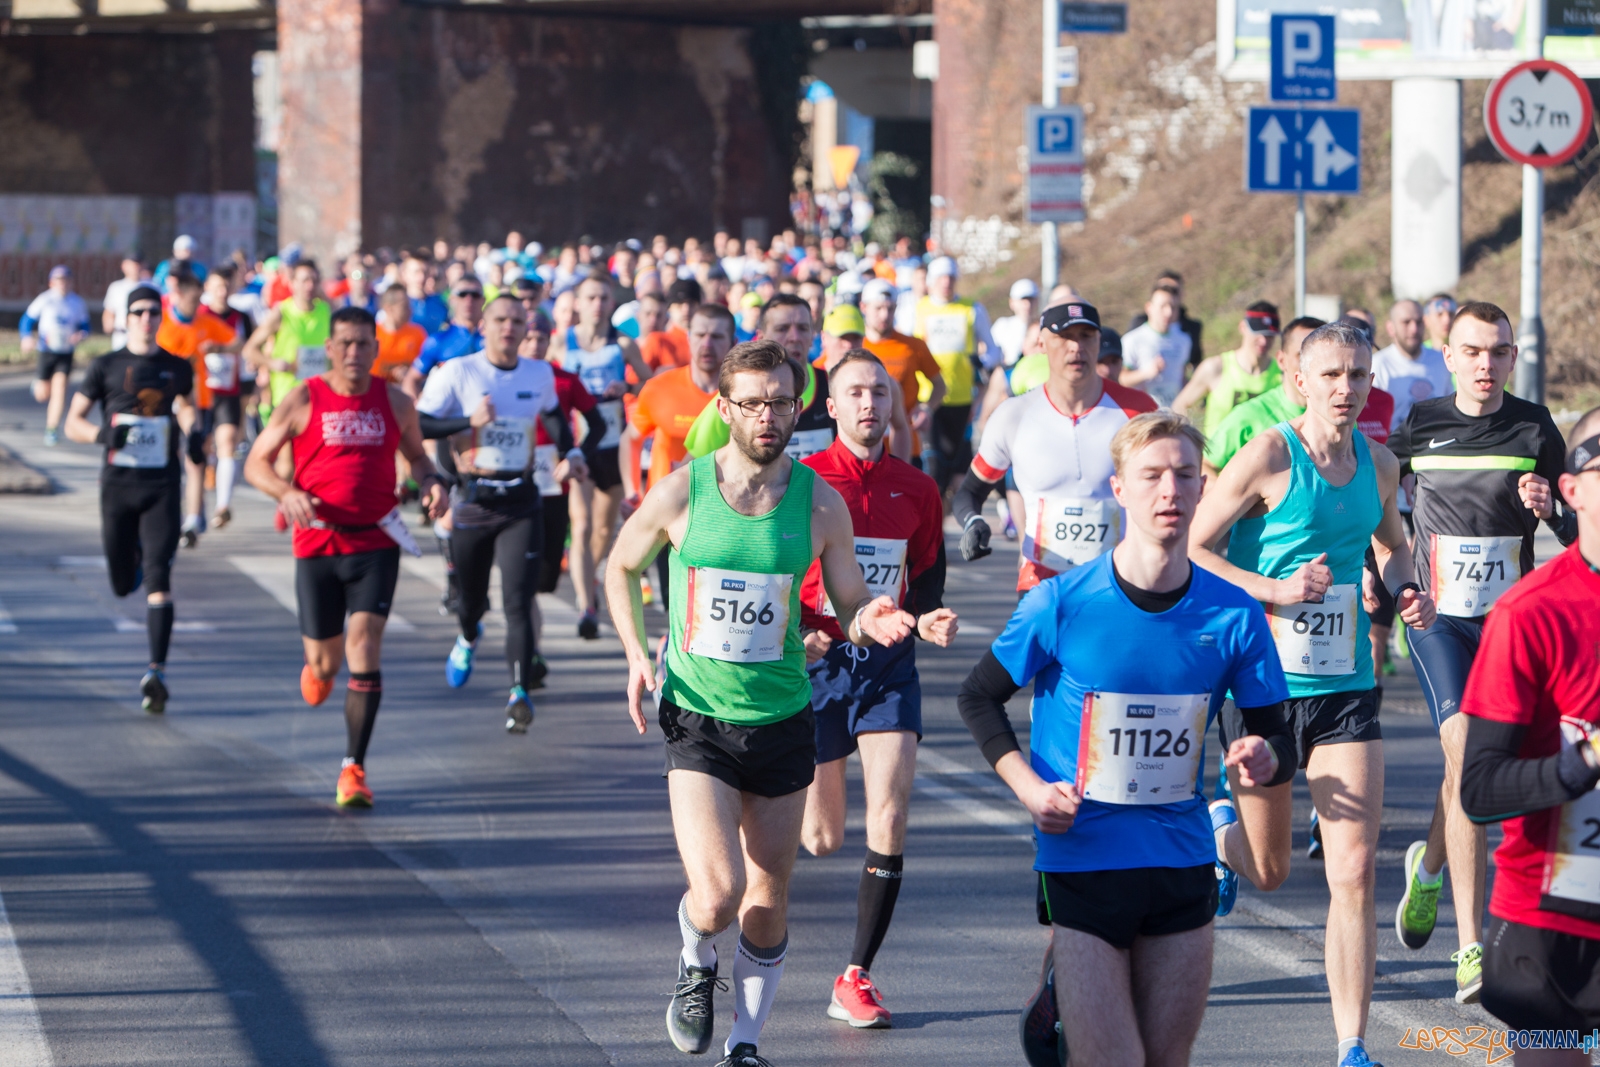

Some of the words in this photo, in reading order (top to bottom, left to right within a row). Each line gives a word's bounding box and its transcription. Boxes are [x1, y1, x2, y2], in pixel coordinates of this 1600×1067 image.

[485, 430, 523, 446] 5957
[1055, 522, 1109, 542] 8927
[1453, 560, 1505, 582] 7471
[709, 597, 774, 625] 5166
[729, 627, 753, 635] Dawid
[1292, 611, 1344, 636] 6211
[1109, 728, 1190, 757] 11126
[1136, 762, 1164, 770] Dawid
